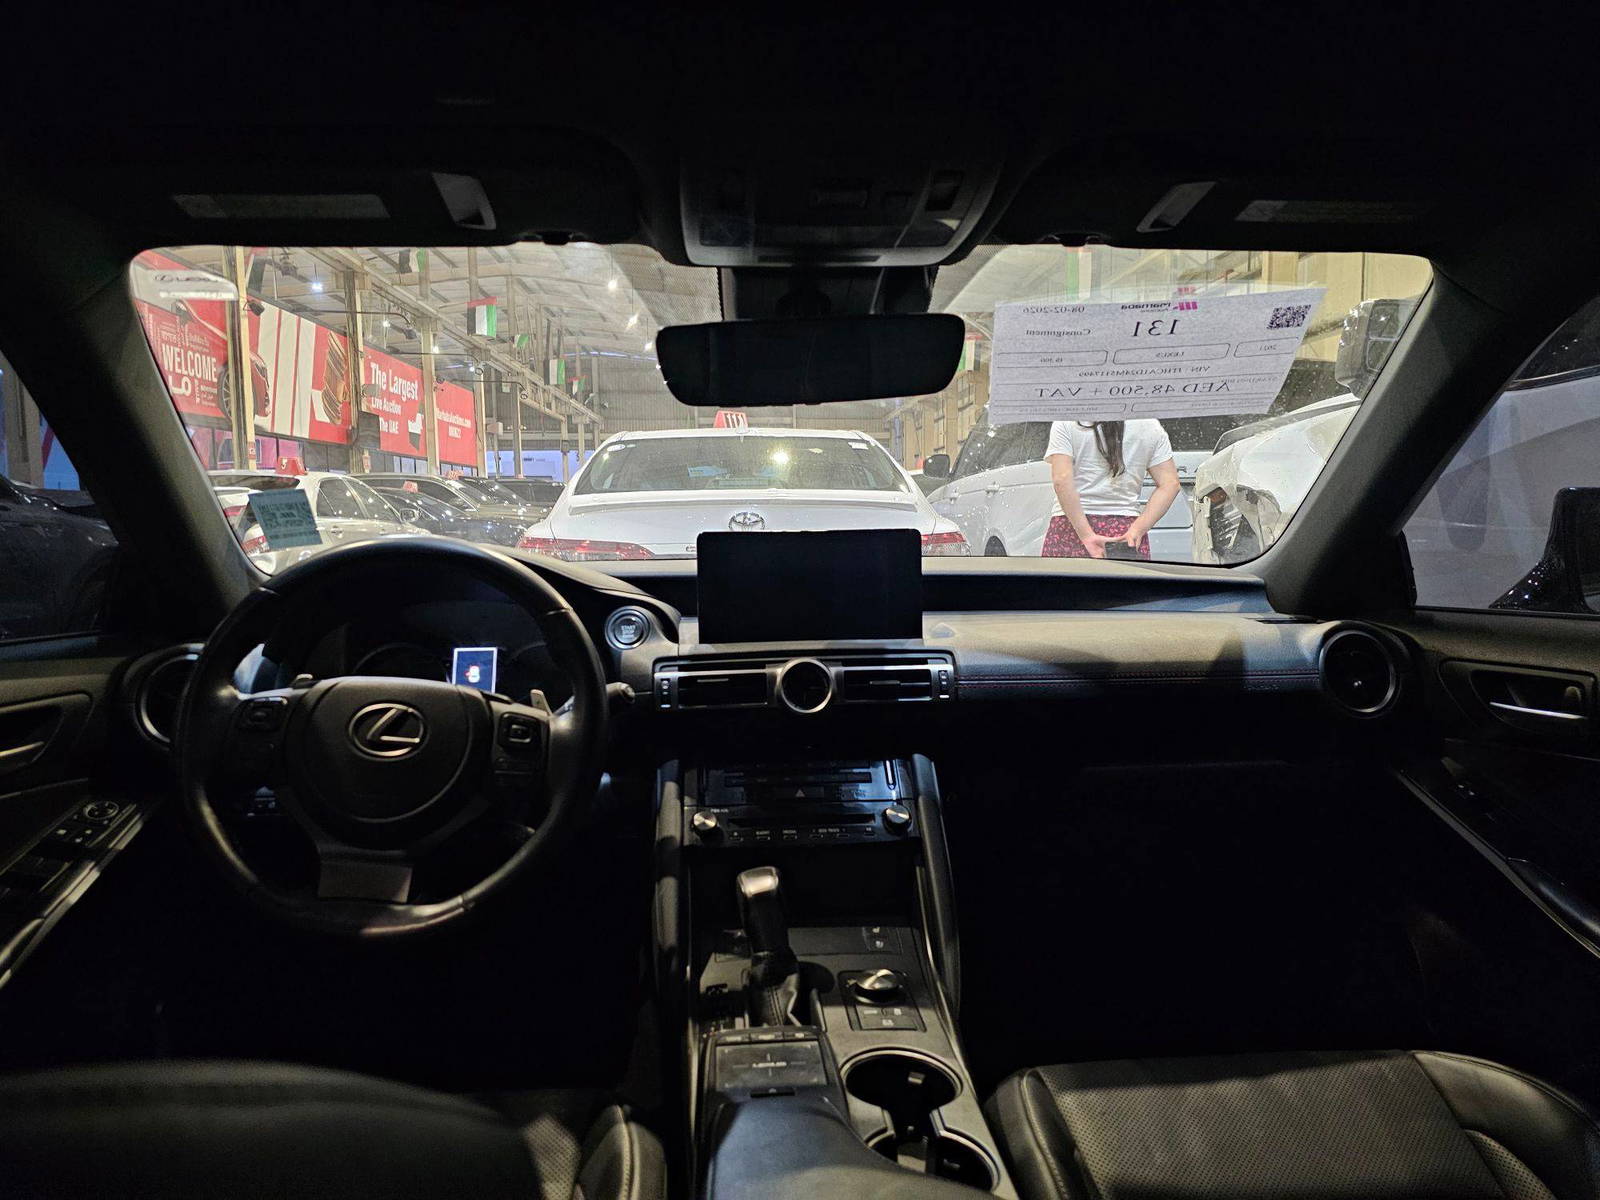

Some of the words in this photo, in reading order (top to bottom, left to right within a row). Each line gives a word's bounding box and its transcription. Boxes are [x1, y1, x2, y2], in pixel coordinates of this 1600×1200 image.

[162, 345, 217, 382] WELCOME
[370, 362, 387, 391] The
[389, 369, 419, 402] Largest
